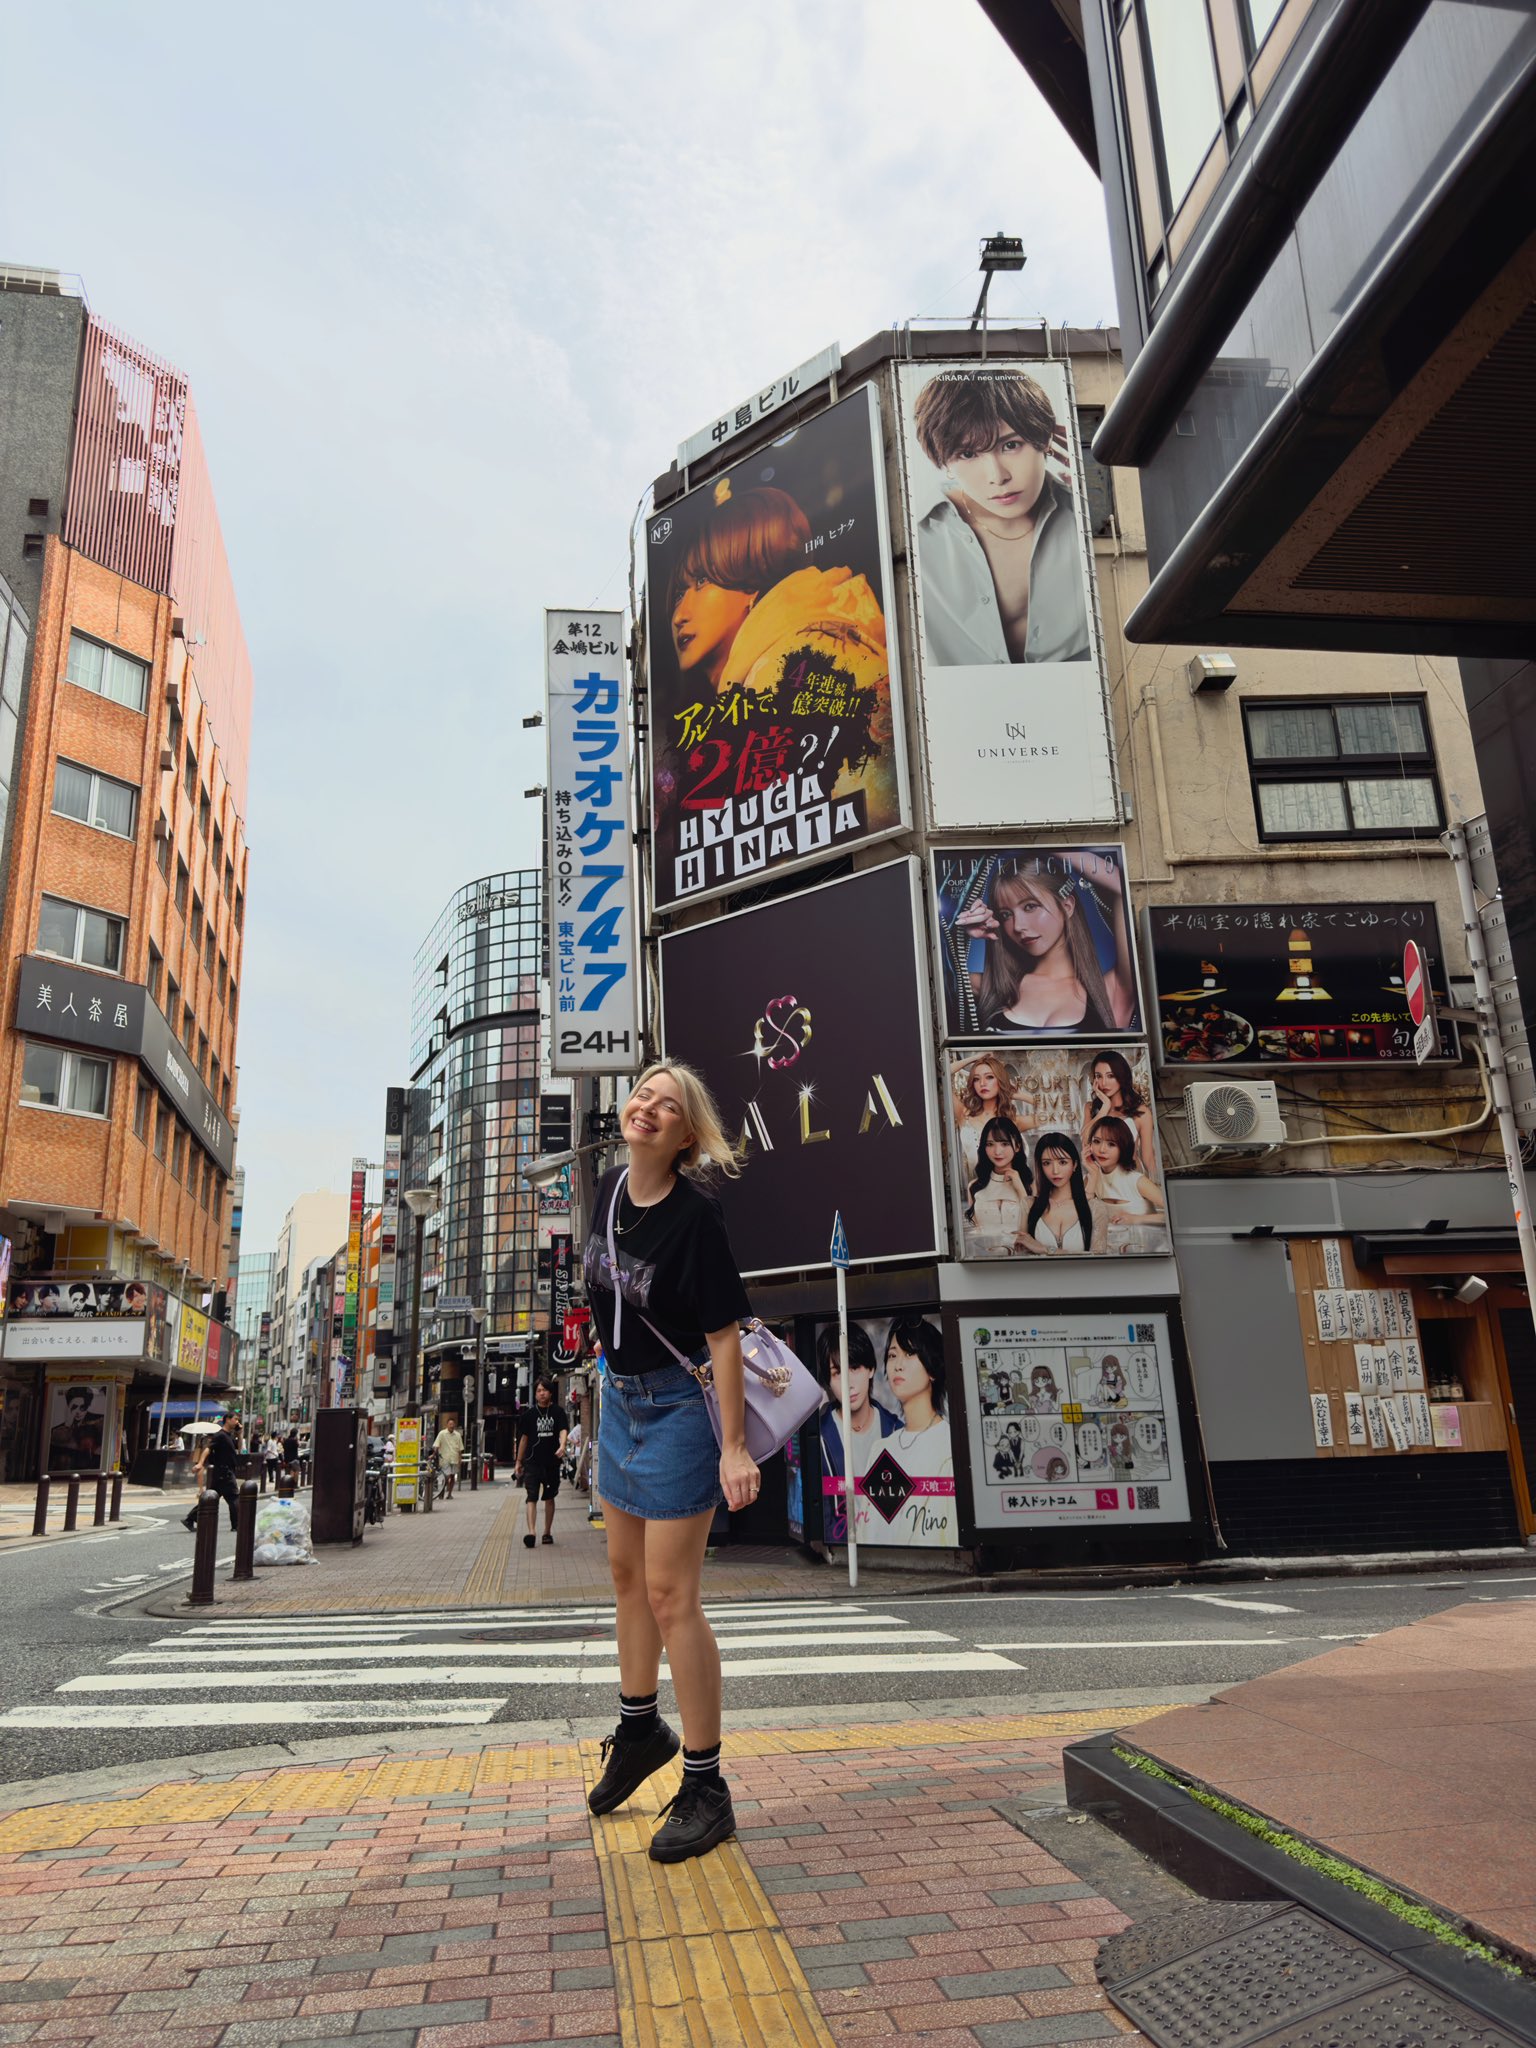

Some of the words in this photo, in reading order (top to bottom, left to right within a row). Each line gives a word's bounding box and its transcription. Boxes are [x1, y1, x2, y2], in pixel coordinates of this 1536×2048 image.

[712, 376, 799, 442] 中島ビル
[828, 518, 855, 540] ヒナタ
[567, 622, 602, 637] 第12
[552, 639, 619, 656] 金嶋ビル
[977, 746, 1060, 758] UNIVERSE
[679, 772, 825, 851] HYUGA
[675, 801, 861, 897] HINATA
[557, 921, 577, 1013] 東宝ビル前
[36, 983, 129, 1029] 美人茶屋
[1351, 1012, 1411, 1023] この先歩いて
[559, 1030, 630, 1054] 24H
[1318, 1293, 1332, 1330] 久保田
[1334, 1294, 1348, 1337] テキーラ
[1360, 1354, 1373, 1385] 白州
[1374, 1357, 1390, 1386] 竹鶴
[1388, 1350, 1403, 1381] 余市
[1406, 1345, 1421, 1377] 宮城峡
[1349, 1403, 1364, 1436] 華金
[869, 1486, 906, 1497] LALA
[1007, 1495, 1078, 1509] 体入ドットコム
[905, 1504, 948, 1537] Nino
